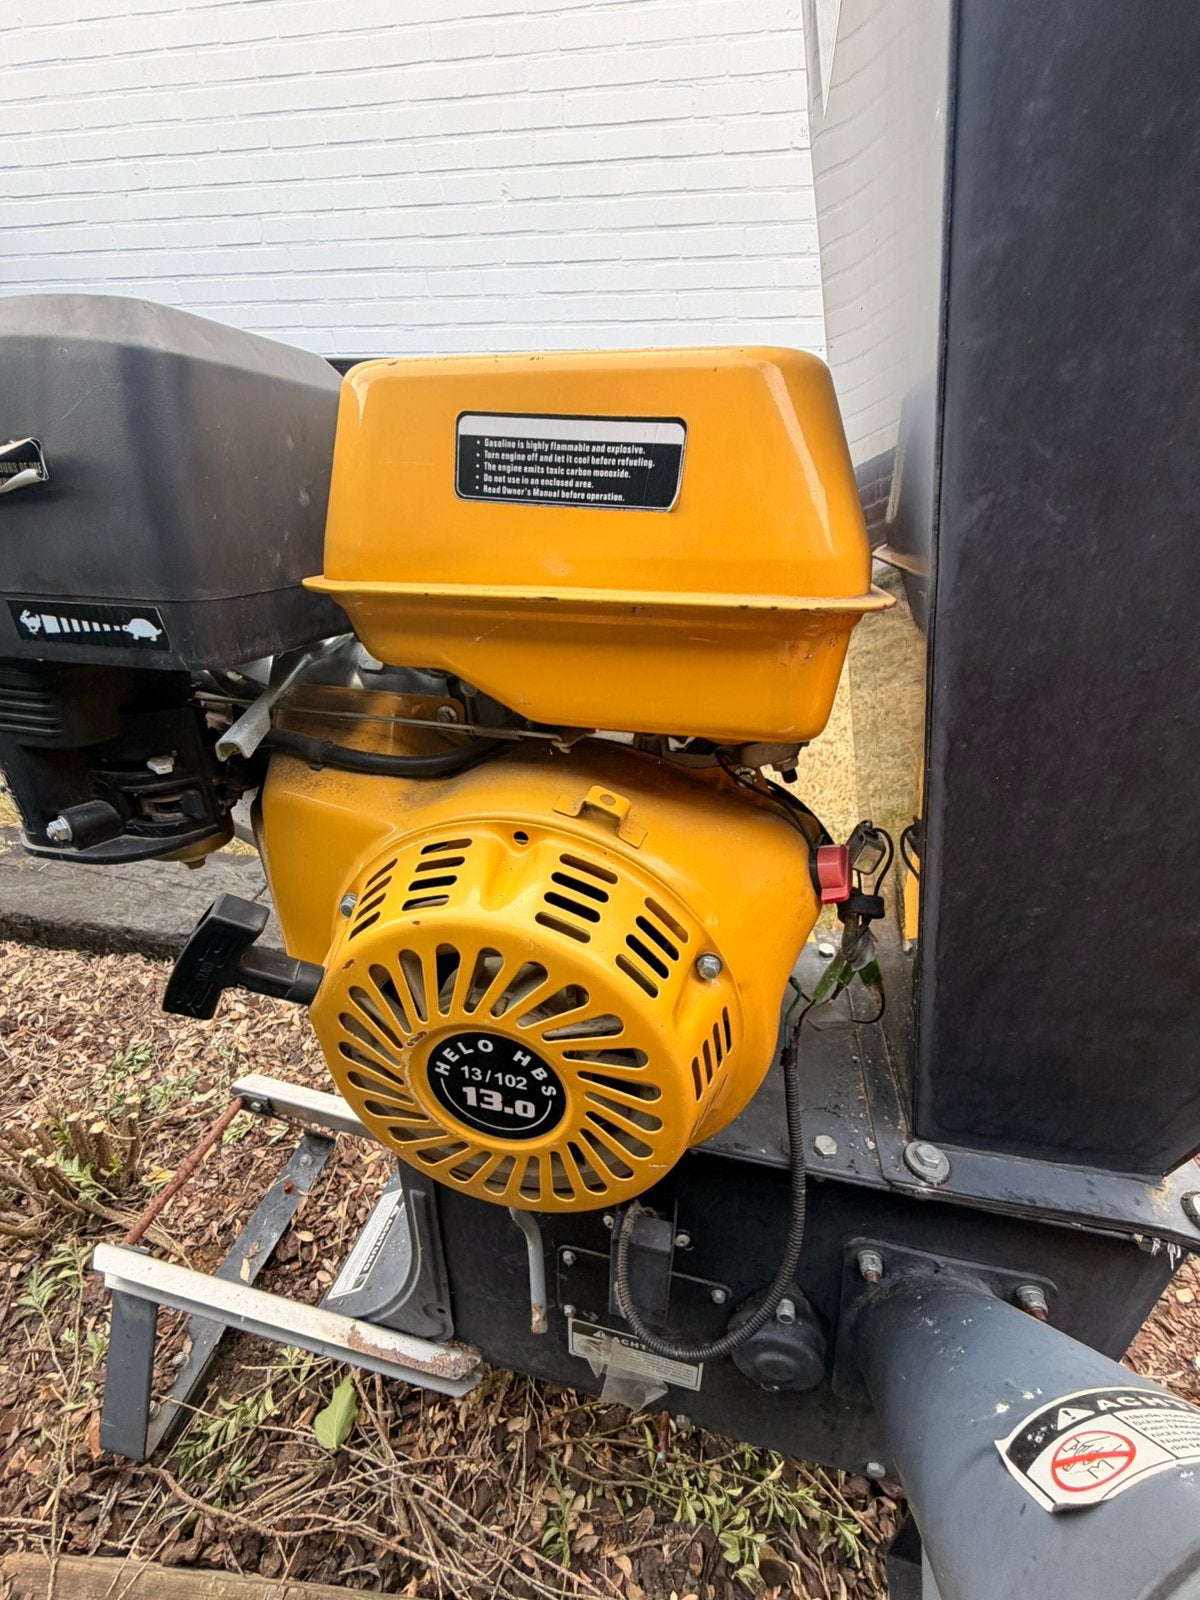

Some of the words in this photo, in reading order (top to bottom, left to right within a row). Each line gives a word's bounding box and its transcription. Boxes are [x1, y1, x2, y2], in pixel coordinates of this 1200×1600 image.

[484, 438, 516, 449] Gasoline
[517, 440, 525, 449] is
[526, 440, 549, 452] highly
[550, 441, 590, 452] flammable
[591, 444, 605, 453] and
[607, 444, 646, 455] explosive.
[484, 450, 500, 459] Turn
[501, 451, 525, 462] engine
[527, 452, 539, 461] off
[539, 454, 554, 462] and
[554, 454, 565, 463] let
[566, 454, 573, 464] it
[573, 455, 590, 465] cool
[591, 455, 616, 466] before
[617, 456, 655, 469] refueling.
[484, 462, 496, 471] The
[498, 463, 522, 473] engine
[524, 465, 545, 474] emits
[546, 466, 565, 475] toxic
[566, 467, 592, 476] carbon
[593, 468, 632, 478] monoxide.
[483, 473, 493, 482] Do
[494, 475, 506, 483] not
[507, 476, 520, 484] use
[521, 475, 529, 485] in
[541, 477, 574, 487] enclosed
[575, 480, 594, 489] area.
[483, 485, 501, 494] Read
[502, 485, 531, 496] Owner's
[533, 487, 559, 498] Manual
[561, 490, 585, 499] before
[586, 492, 625, 502] operation.
[435, 1039, 494, 1076] HELO
[461, 1065, 528, 1091] 13/102
[462, 1086, 536, 1119] 13.0
